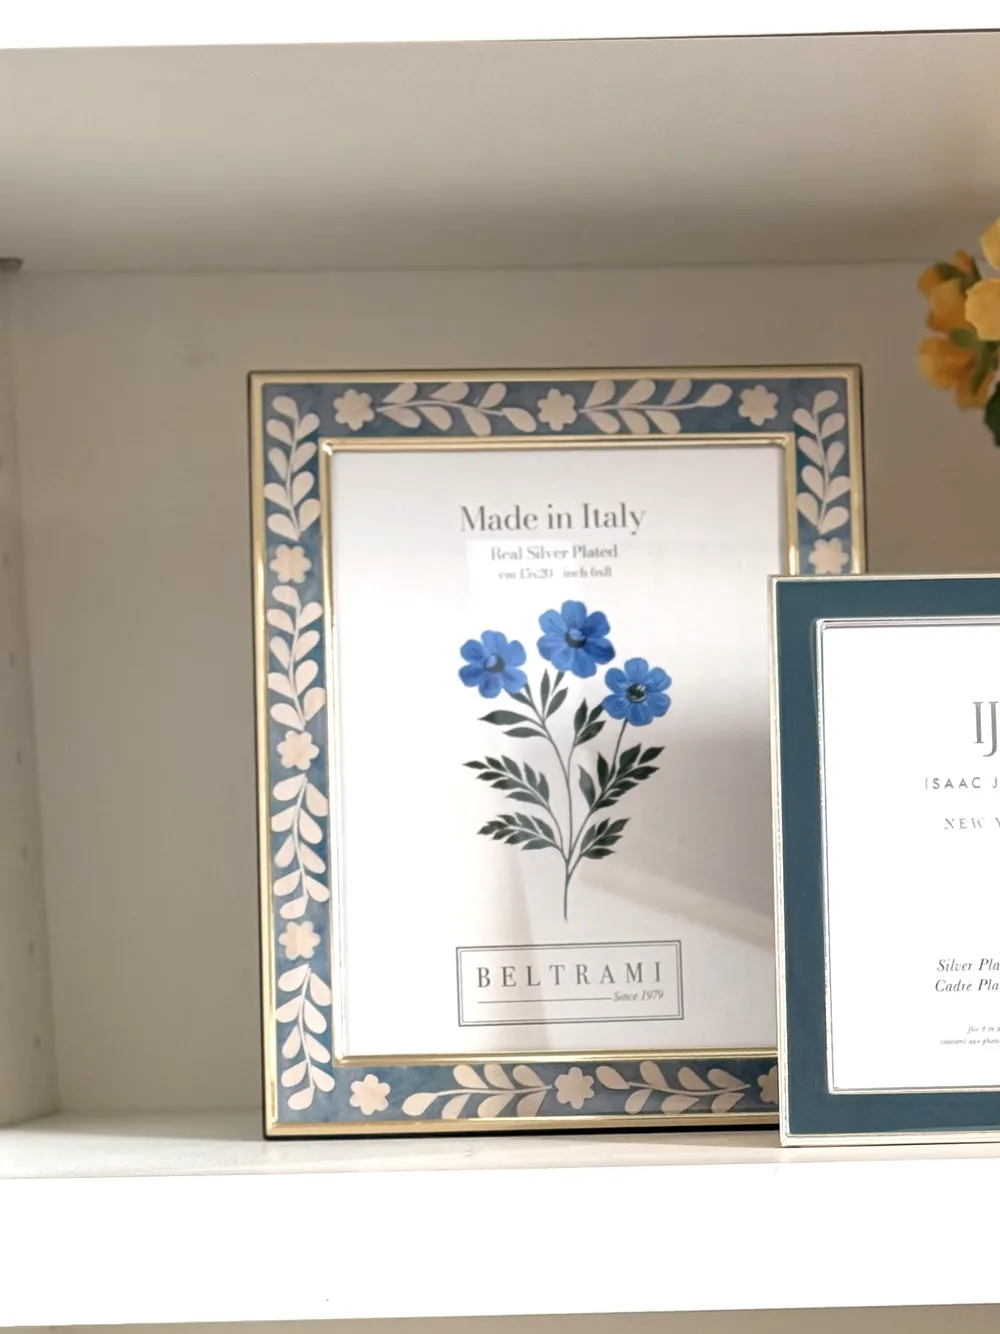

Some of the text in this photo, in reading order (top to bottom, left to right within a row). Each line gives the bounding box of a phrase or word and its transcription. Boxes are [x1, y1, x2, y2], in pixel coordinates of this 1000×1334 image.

[459, 502, 646, 536] Made in Italy
[491, 544, 618, 561] Real Silver Plated
[925, 776, 981, 790] ISAAC
[944, 816, 984, 830] NEW
[936, 958, 973, 972] Silver
[477, 961, 661, 988] BELTRAMI
[934, 978, 973, 992] Cadre
[613, 988, 665, 1002] Since 1979
